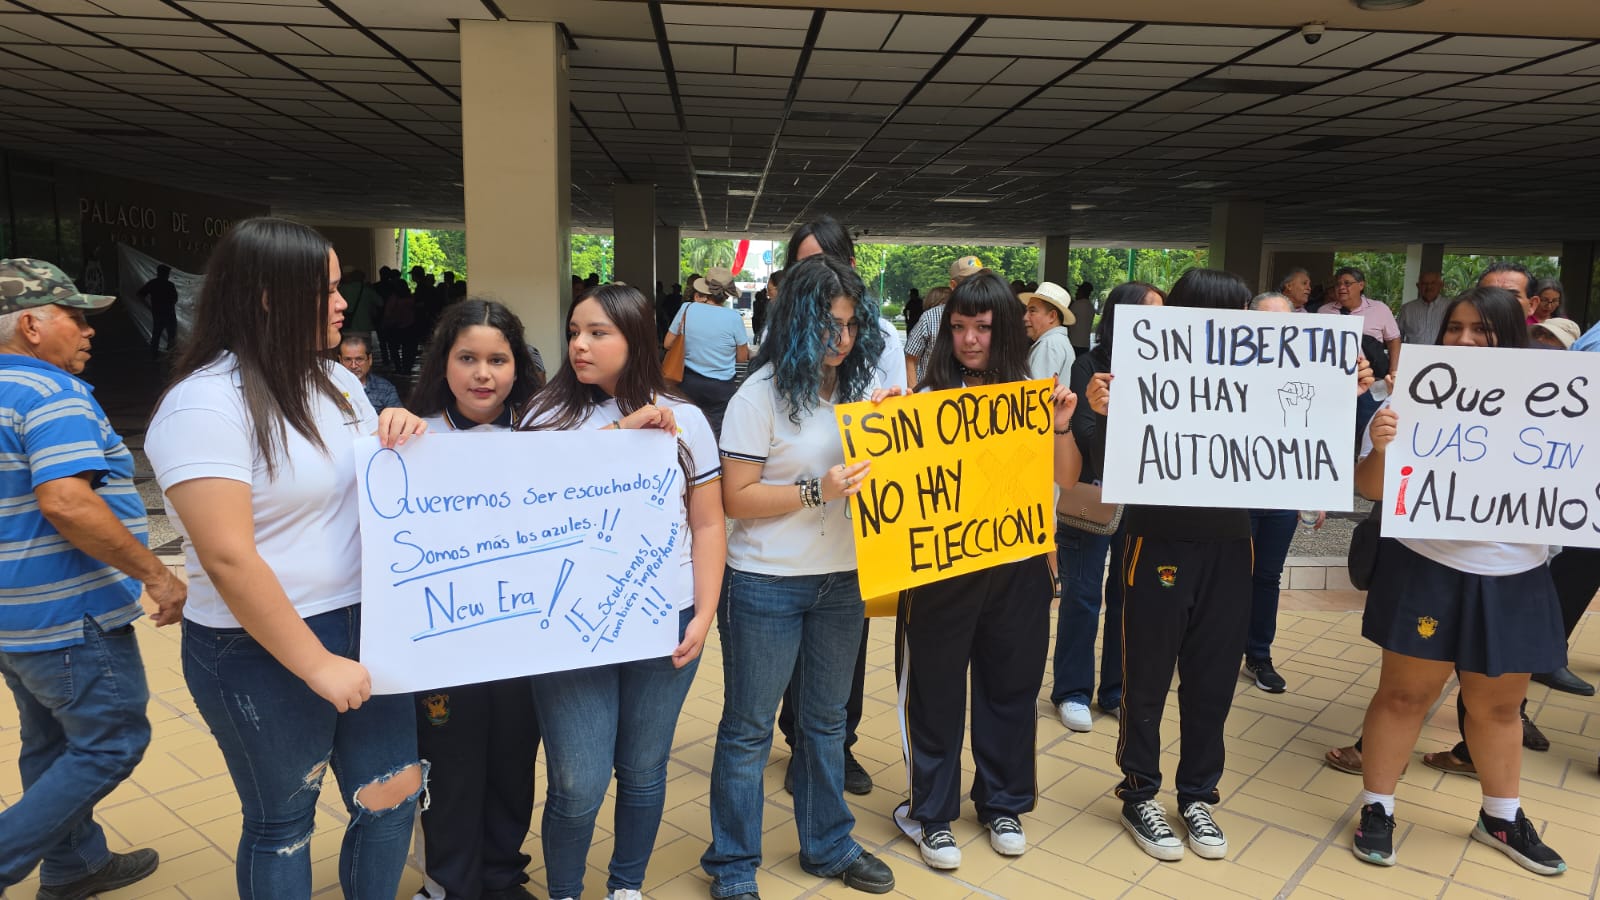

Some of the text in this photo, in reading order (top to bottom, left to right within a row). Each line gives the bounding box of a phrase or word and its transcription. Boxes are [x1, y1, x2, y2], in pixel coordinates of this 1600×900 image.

[79, 198, 157, 230] PALACIO
[172, 211, 190, 233] DE
[1132, 318, 1359, 375] SIN LIBERTAD
[936, 385, 1052, 445] OPCIONES
[1137, 373, 1249, 414] NO HAY
[1408, 362, 1505, 417] Que
[1138, 424, 1339, 485] AUTONOMIA
[1411, 422, 1584, 470] UAS SIN
[366, 447, 511, 519] Queremos
[856, 459, 963, 538] NO HAY
[390, 530, 471, 574] Somos
[476, 533, 511, 555] más
[516, 529, 538, 545] los
[633, 521, 679, 587] importamos
[909, 503, 1047, 572] ELECCIÓN!
[424, 581, 484, 629] New
